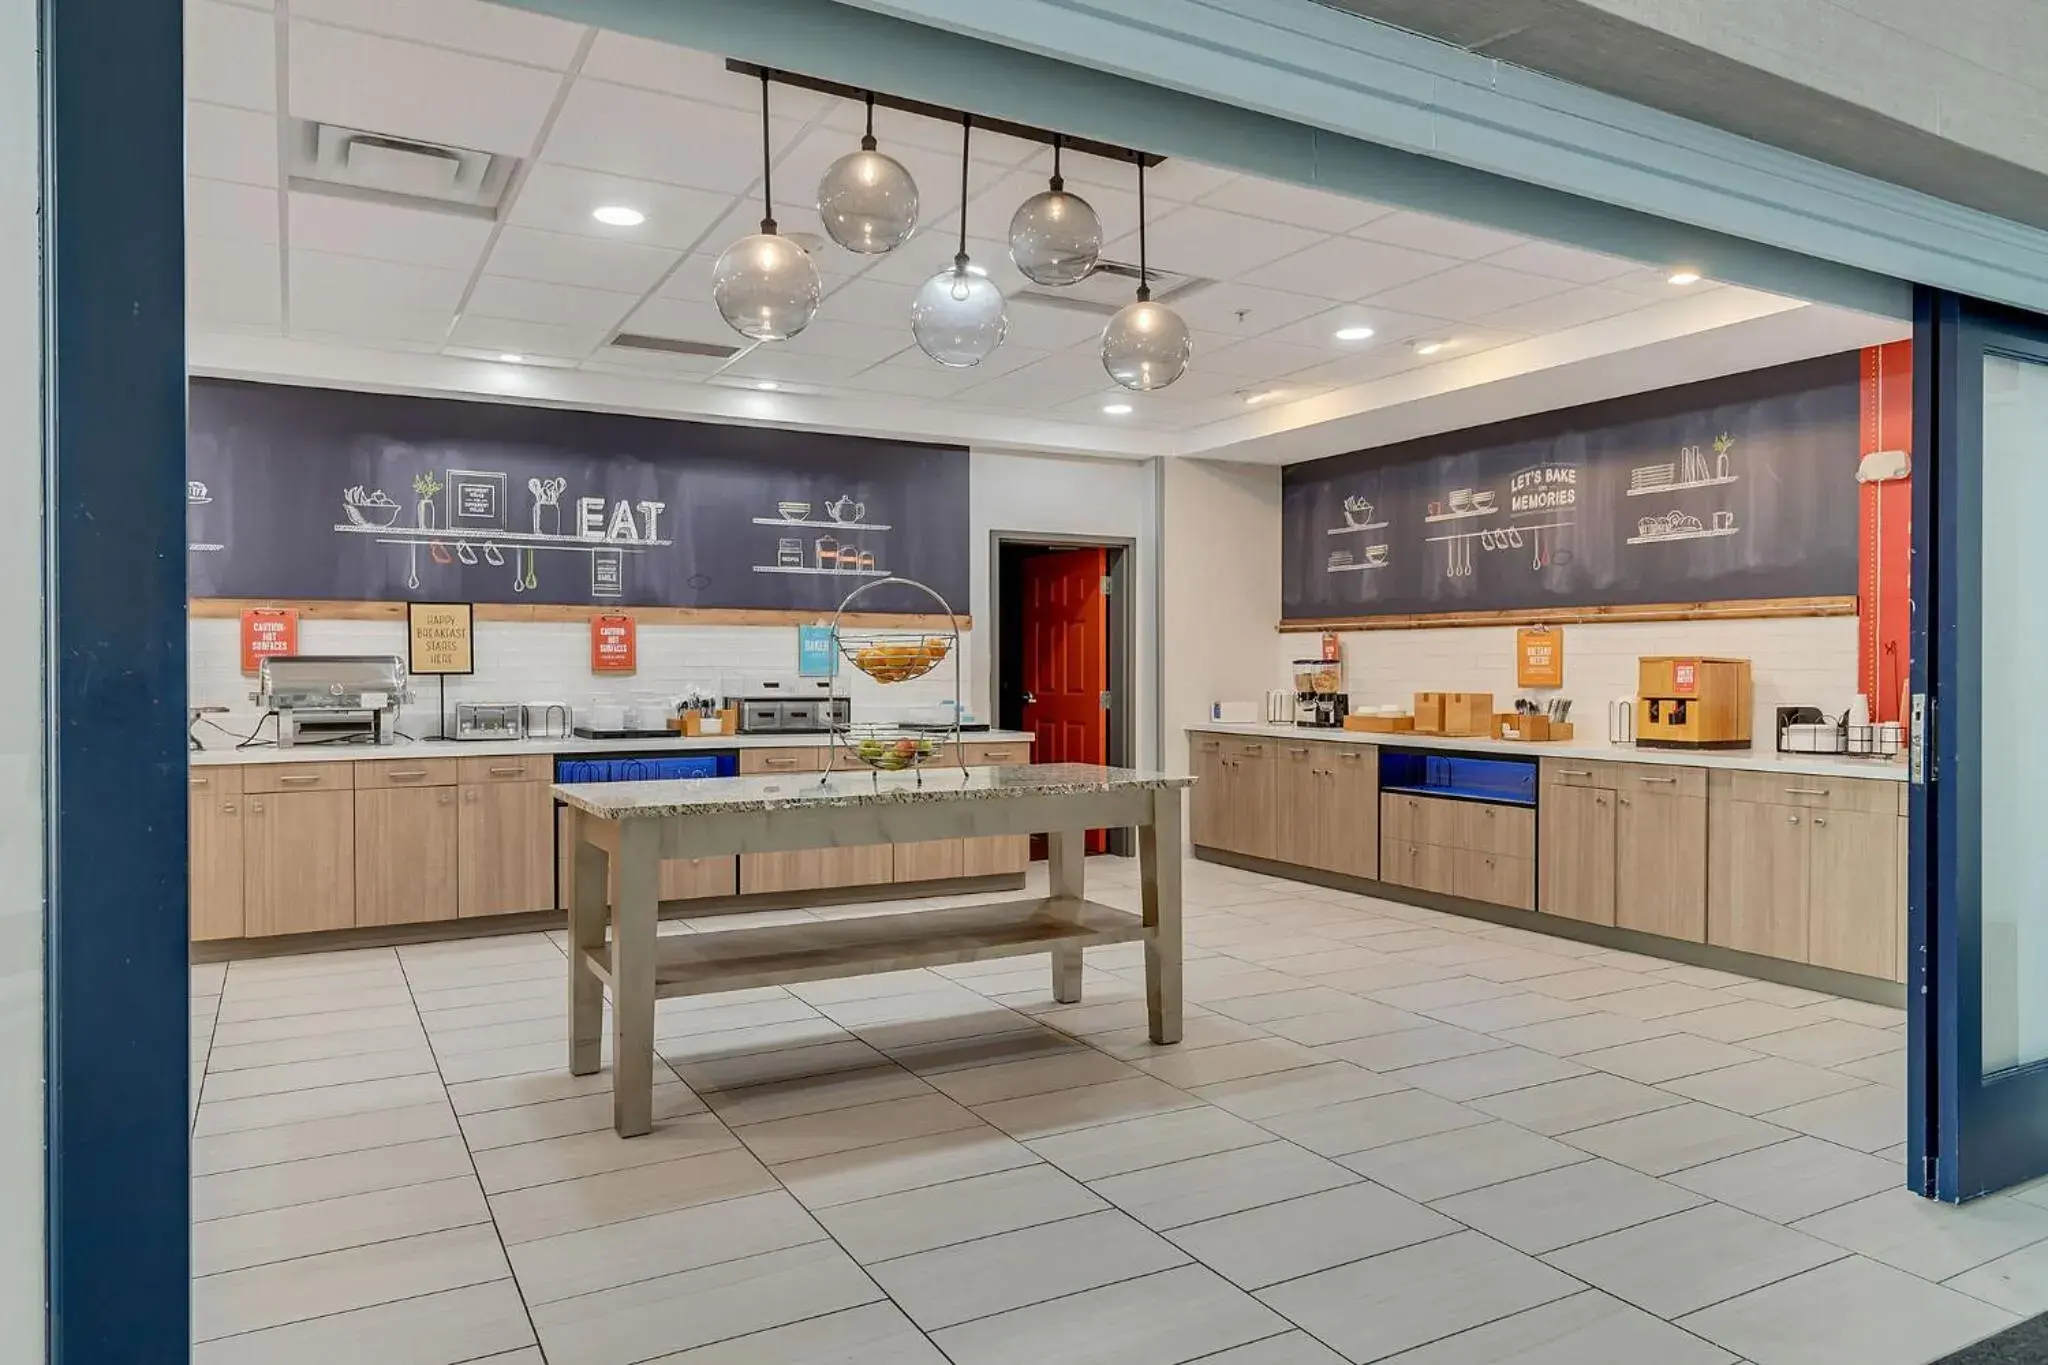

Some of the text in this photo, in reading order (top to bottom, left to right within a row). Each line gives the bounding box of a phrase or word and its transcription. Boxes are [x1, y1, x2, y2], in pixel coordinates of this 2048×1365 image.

[1511, 468, 1576, 493] LET'S BAKE
[1511, 489, 1575, 512] MEMORIES
[577, 497, 666, 541] EAT
[427, 614, 455, 625] HAPPY
[416, 628, 466, 638] BREAKFAST
[252, 641, 288, 650] SURFACES
[425, 641, 457, 651] STARTS
[804, 640, 833, 651] BAKER
